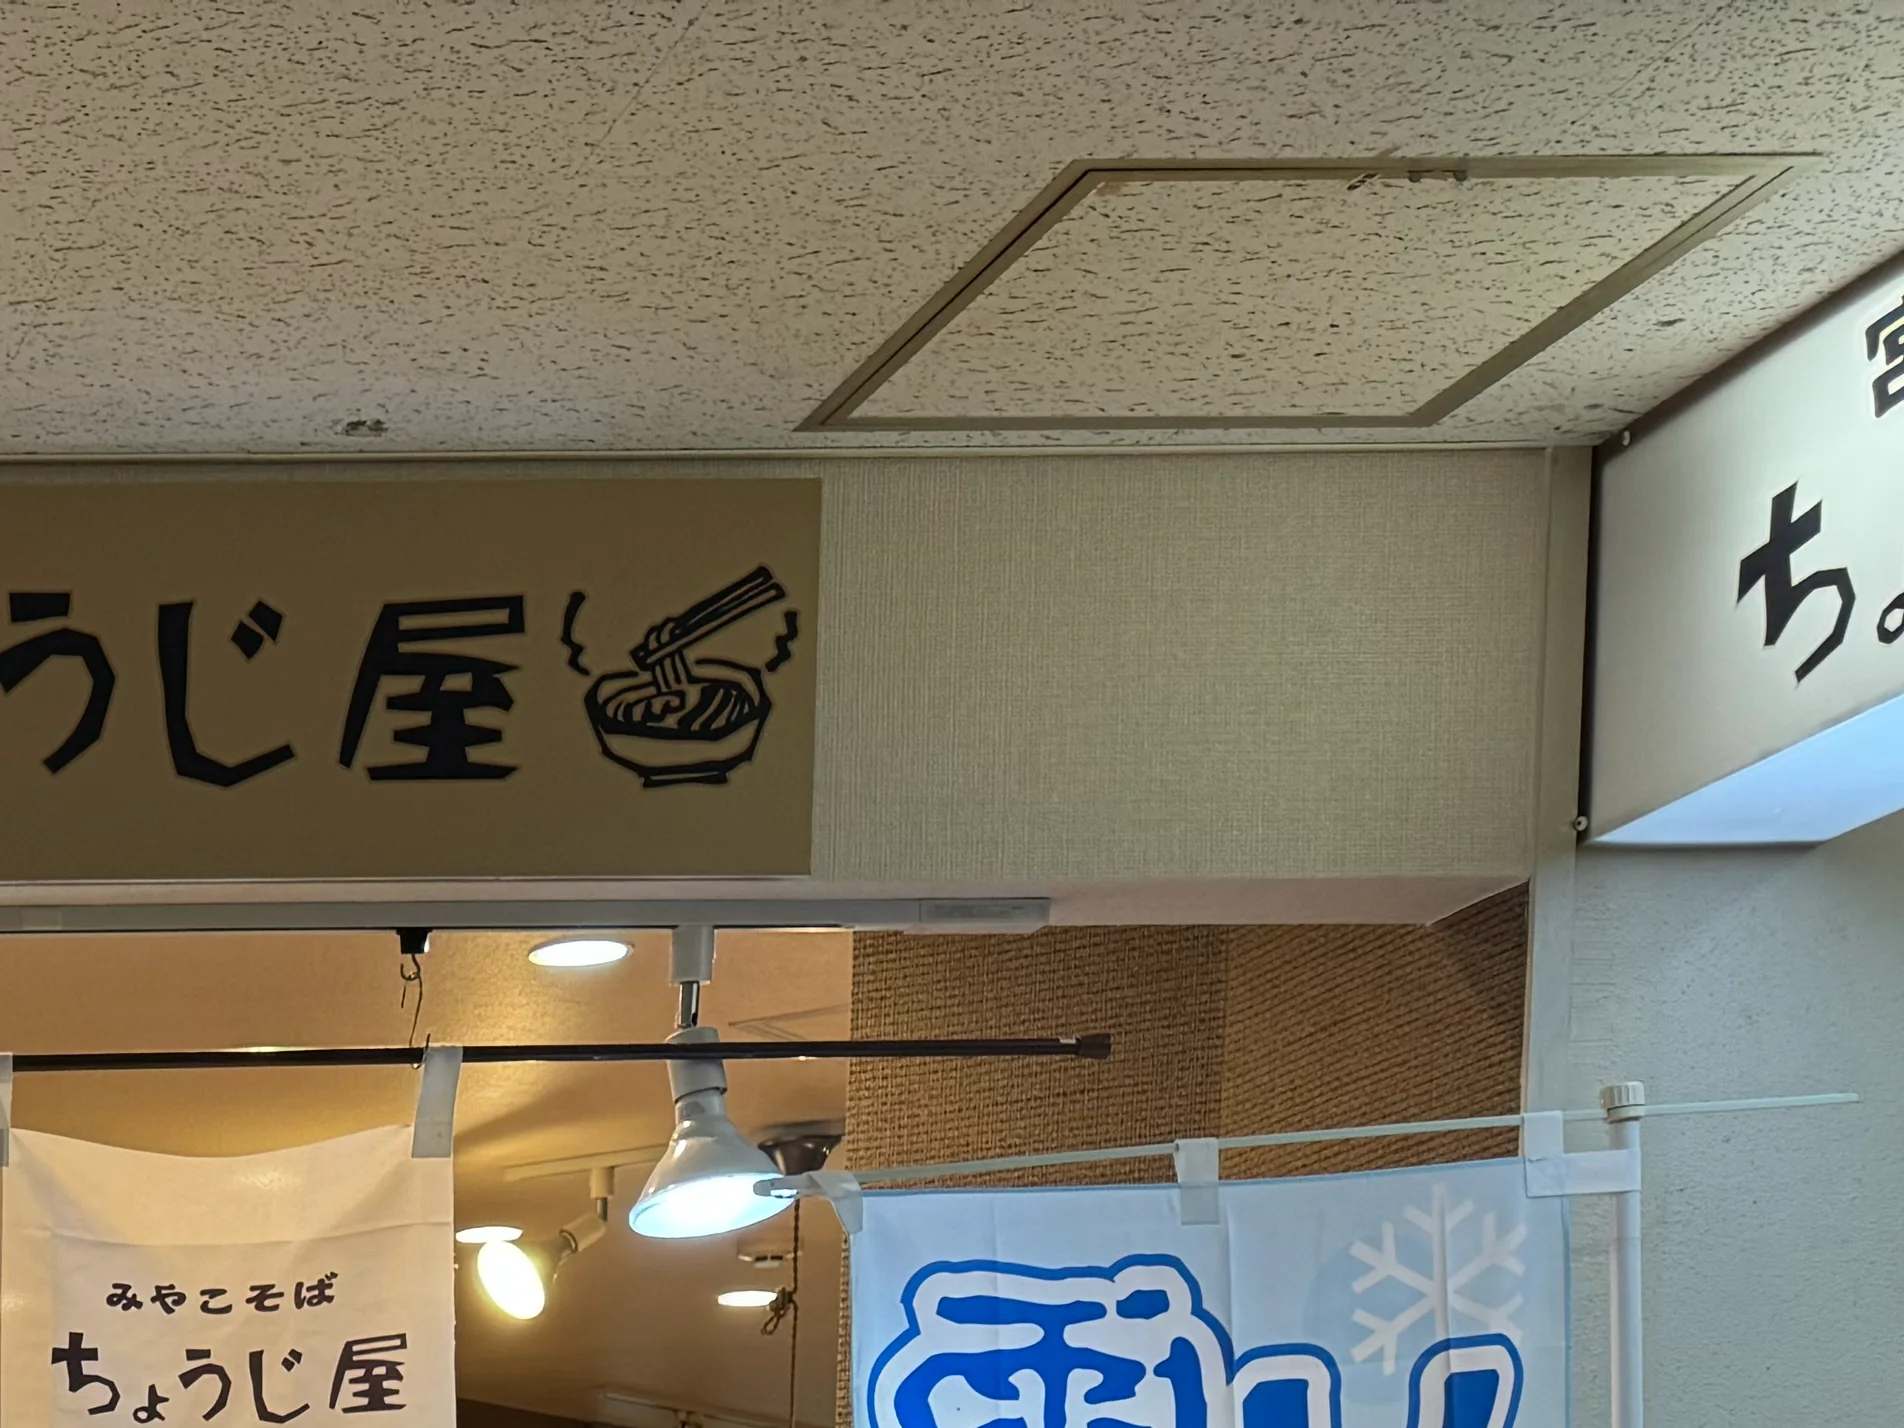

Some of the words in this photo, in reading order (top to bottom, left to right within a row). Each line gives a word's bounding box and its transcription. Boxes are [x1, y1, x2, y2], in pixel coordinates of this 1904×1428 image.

[106, 1271, 339, 1316] みやこそば
[51, 1331, 408, 1425] ちょうじ屋
